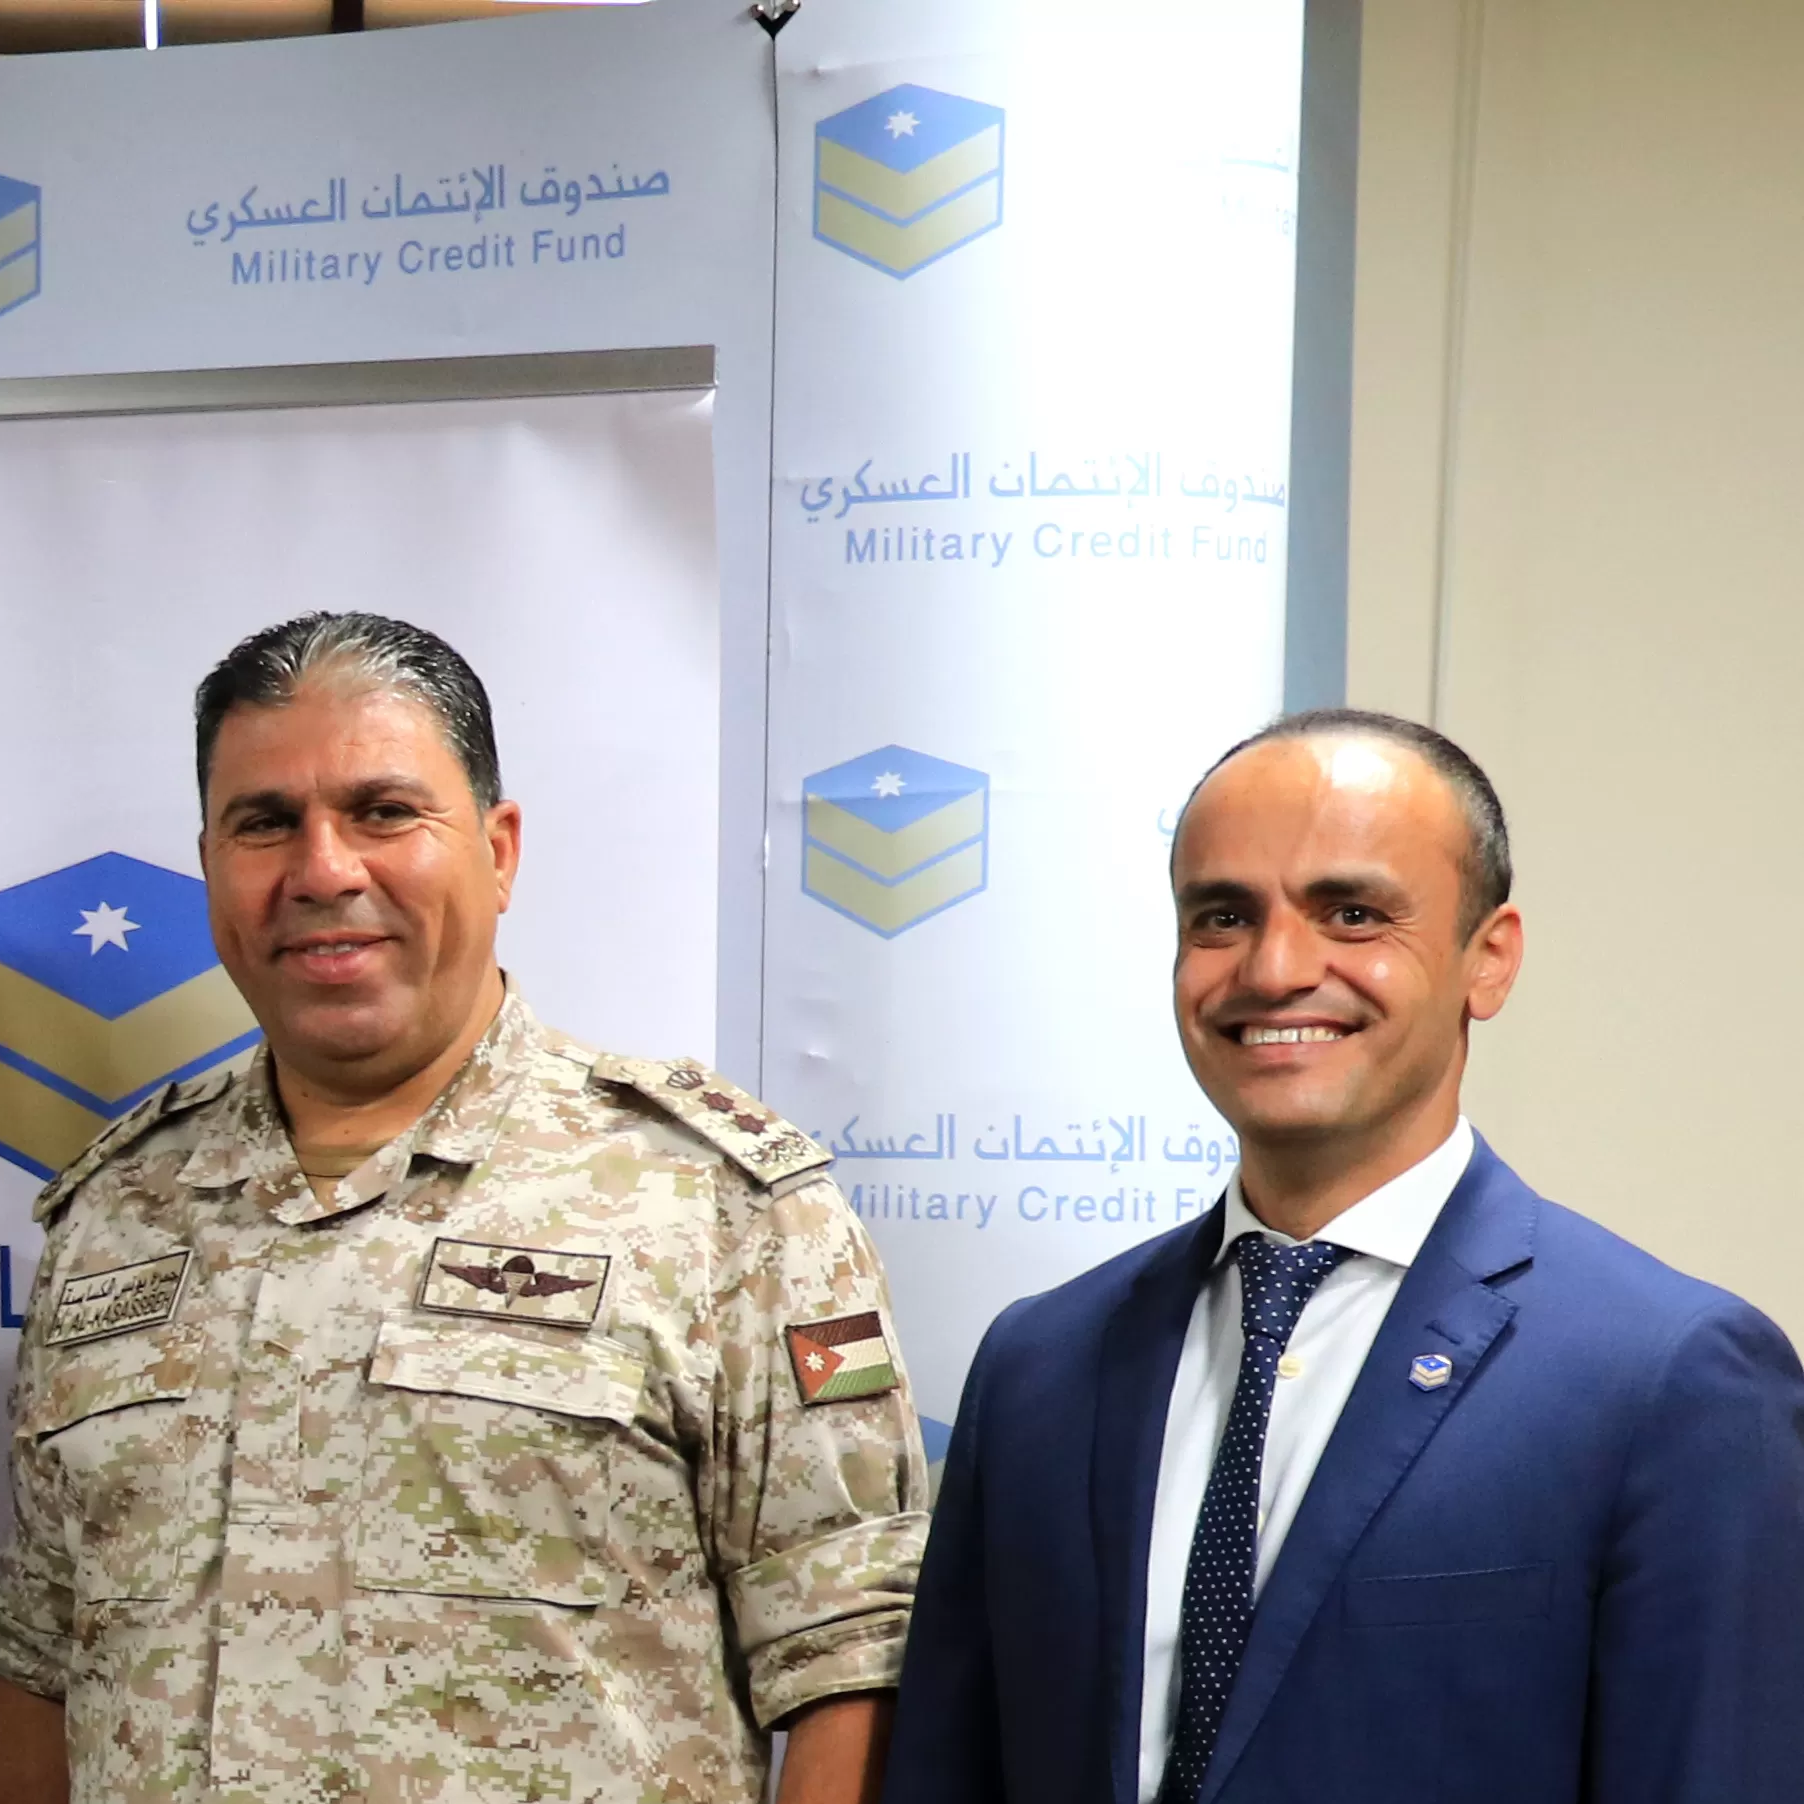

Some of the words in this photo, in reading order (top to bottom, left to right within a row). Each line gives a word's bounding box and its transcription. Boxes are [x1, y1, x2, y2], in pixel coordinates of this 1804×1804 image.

[186, 178, 346, 247] العسكري
[520, 162, 670, 216] صندوق
[232, 250, 381, 286] Military
[398, 234, 514, 275] Credit
[533, 224, 626, 264] Fund
[799, 452, 971, 525] العسكري
[845, 527, 1013, 568] Military
[1033, 522, 1172, 560] Credit
[1193, 525, 1267, 565] Fund
[810, 1113, 955, 1172] العسكر
[1163, 1123, 1241, 1177] دوق
[1017, 1186, 1156, 1223] Credit
